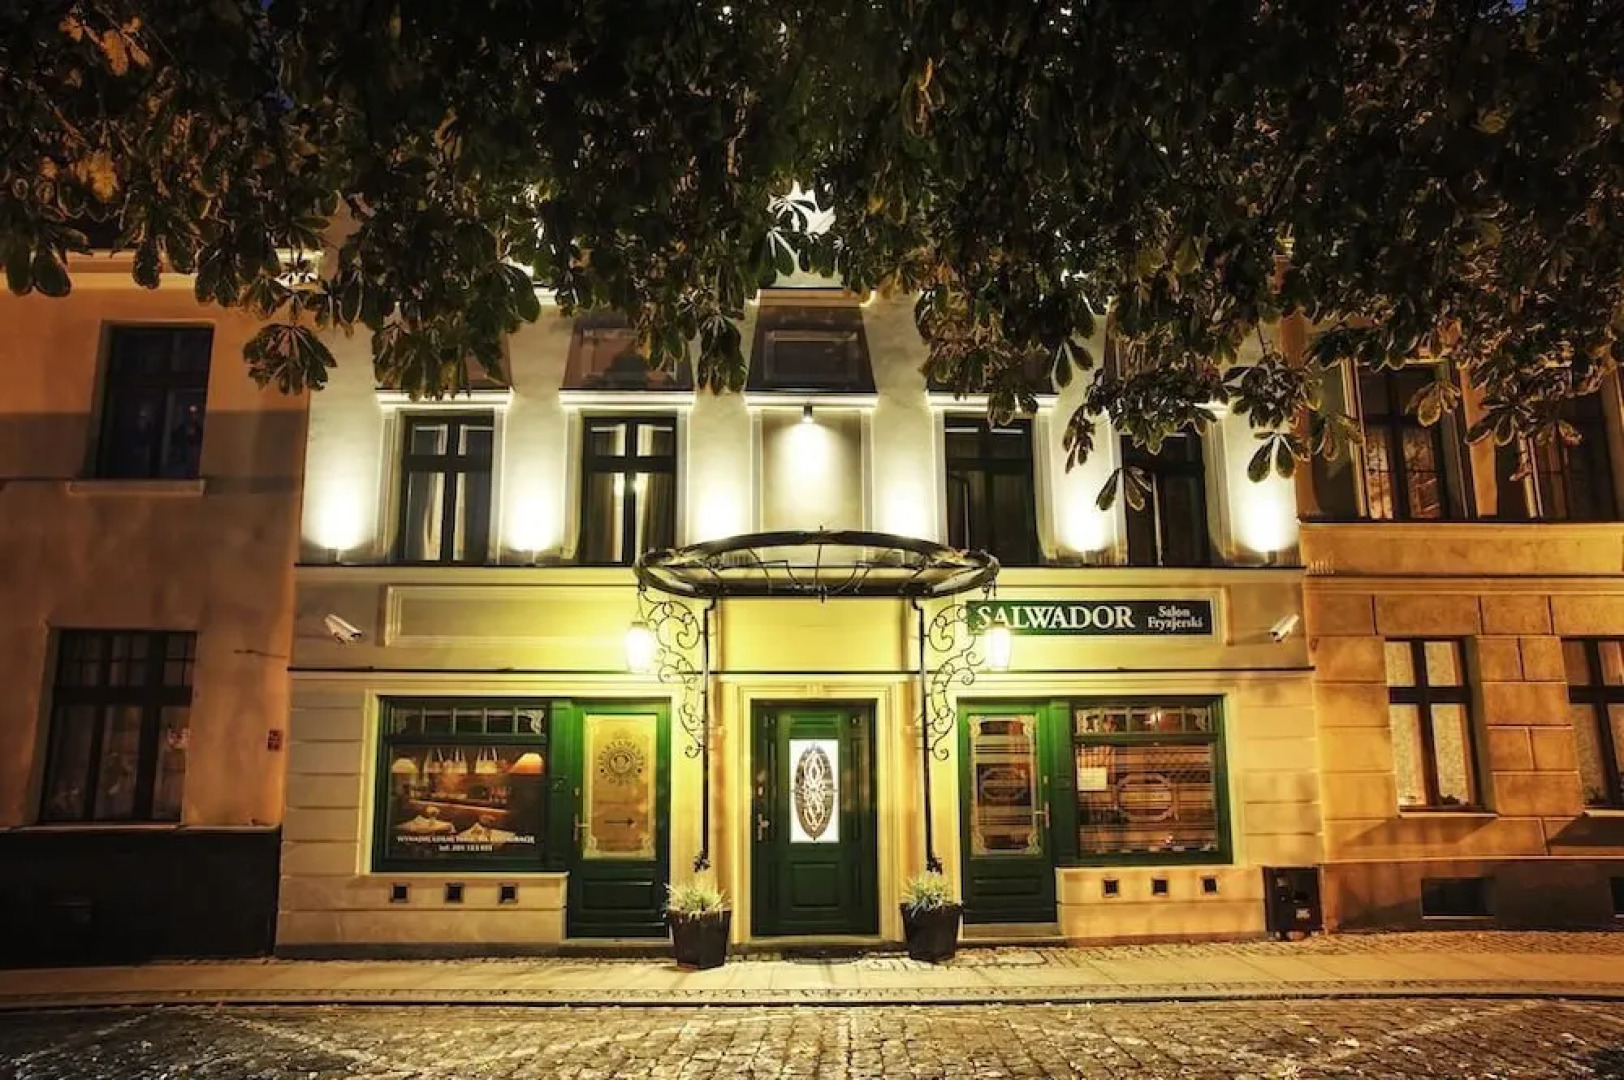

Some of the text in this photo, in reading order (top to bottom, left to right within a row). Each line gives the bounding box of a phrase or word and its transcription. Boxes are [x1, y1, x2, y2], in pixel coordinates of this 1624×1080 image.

[977, 605, 1135, 629] SALWADOR
[1158, 605, 1191, 618] Salon
[1147, 616, 1203, 631] Fryzjerski
